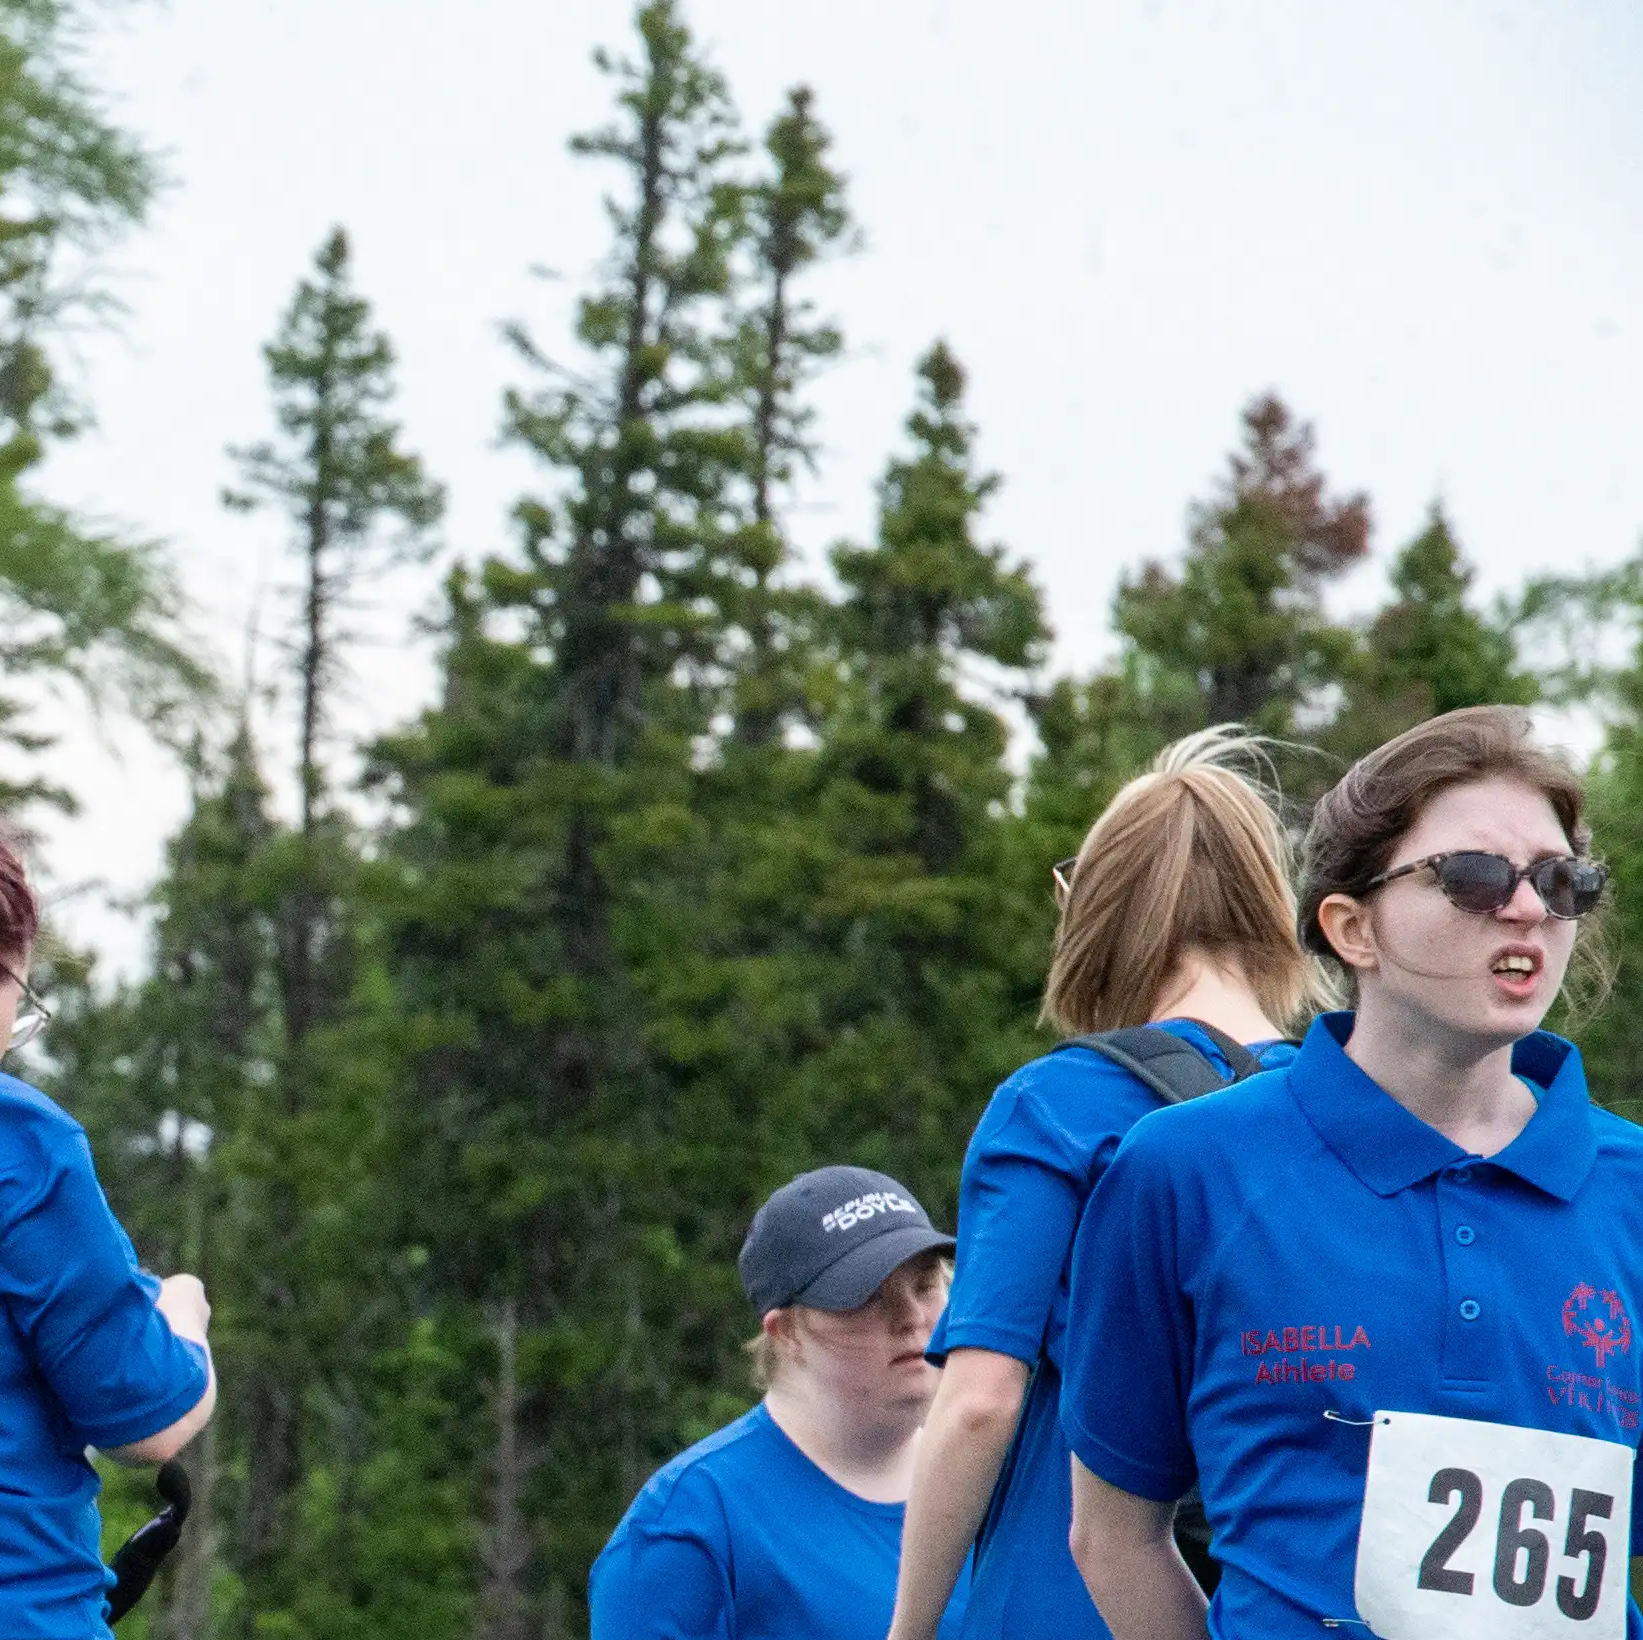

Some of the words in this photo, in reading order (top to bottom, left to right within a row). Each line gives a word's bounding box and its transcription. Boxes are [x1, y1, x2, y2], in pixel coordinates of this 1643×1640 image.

[1241, 1325, 1371, 1356] ISABELLA
[1255, 1358, 1355, 1385] Athlete
[1416, 1467, 1615, 1621] 265
